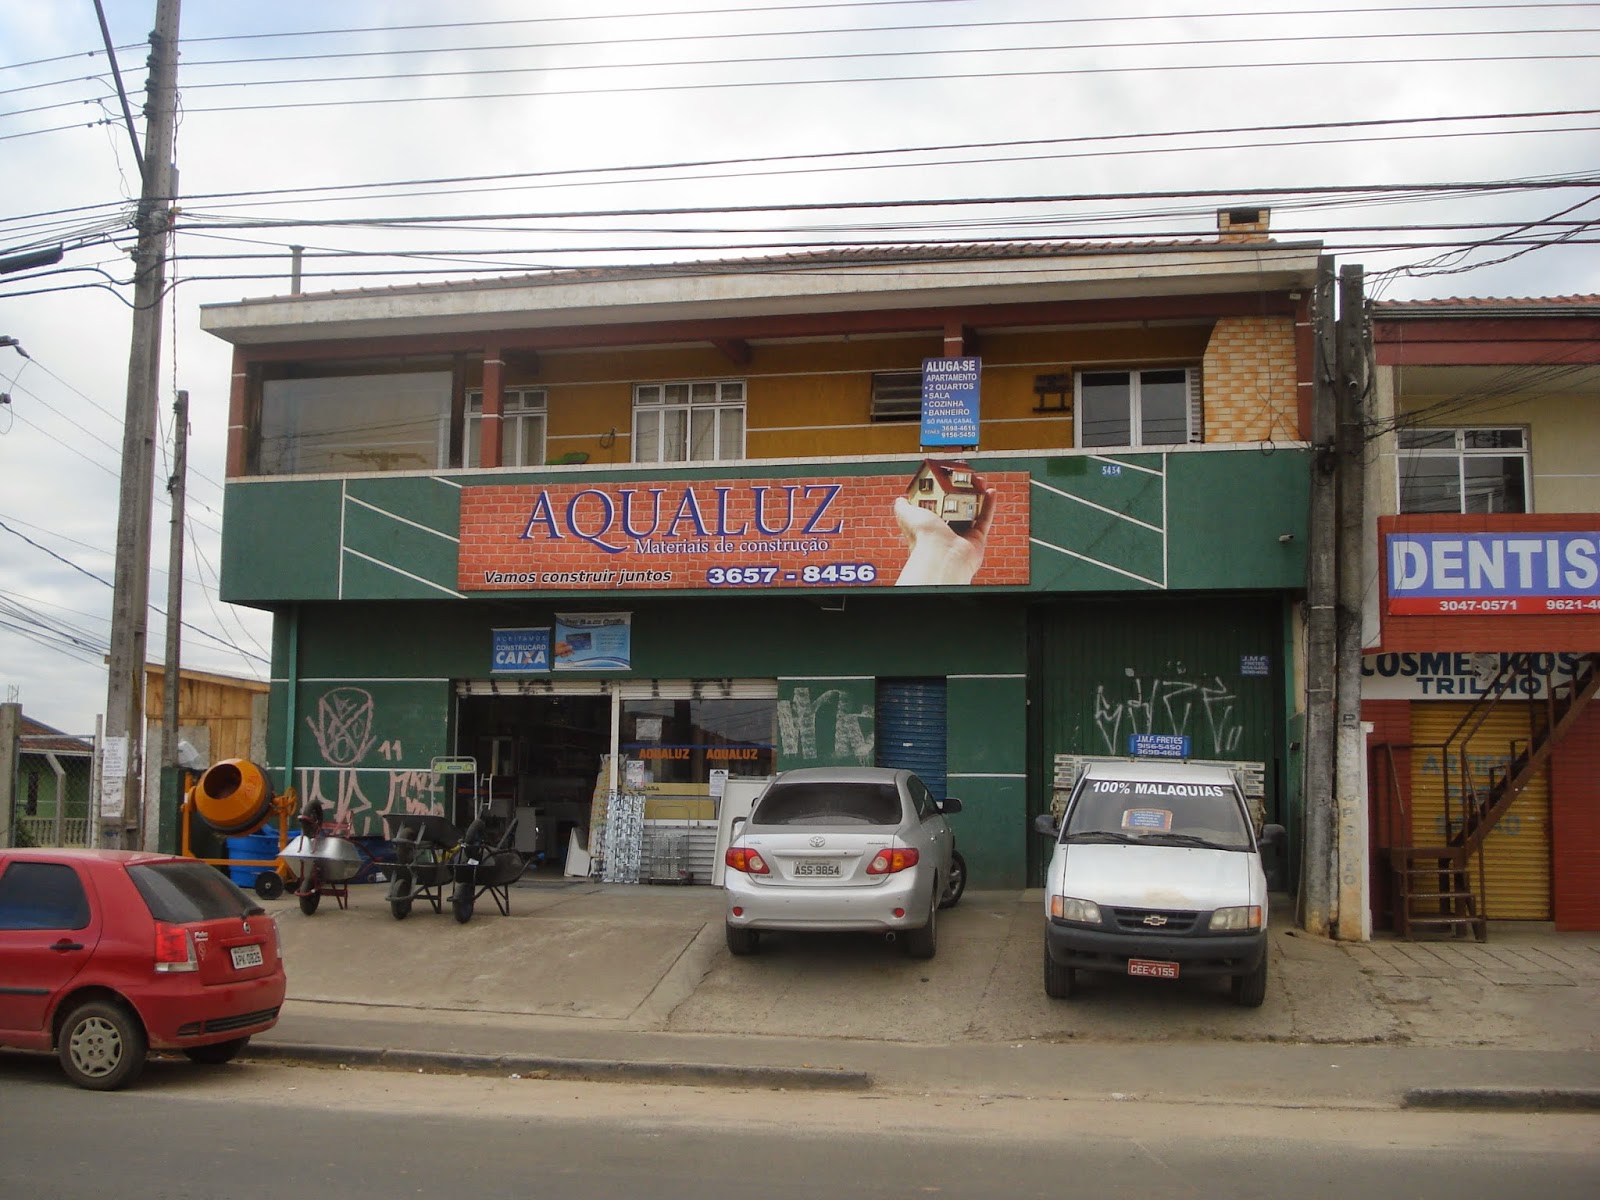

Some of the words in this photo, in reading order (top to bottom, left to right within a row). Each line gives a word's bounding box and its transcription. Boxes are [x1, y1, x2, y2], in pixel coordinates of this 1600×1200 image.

[926, 360, 975, 372] ALUGA-SE
[926, 373, 977, 382] APARTAMENTO
[1102, 465, 1121, 475] 5434
[518, 484, 844, 553] AQUALUZ
[634, 538, 709, 554] Materiais
[710, 536, 735, 552] de
[739, 537, 829, 556] construção
[1392, 538, 1600, 590] DENTIS
[484, 570, 536, 583] Vamos
[541, 570, 615, 583] construir
[617, 569, 672, 586] juntos
[708, 567, 778, 584] 3657
[803, 565, 876, 583] 8456
[1439, 600, 1518, 611] 3047-0571
[495, 651, 546, 664] CAIXA
[1416, 677, 1542, 694] TRILHO
[1156, 736, 1183, 744] FRETES
[639, 748, 690, 760] AQUALUZ
[706, 748, 758, 760] AQUALUZ
[1137, 748, 1181, 756] 3698-4616
[1093, 781, 1130, 794] 100%
[1135, 783, 1224, 797] MALAQUIAS
